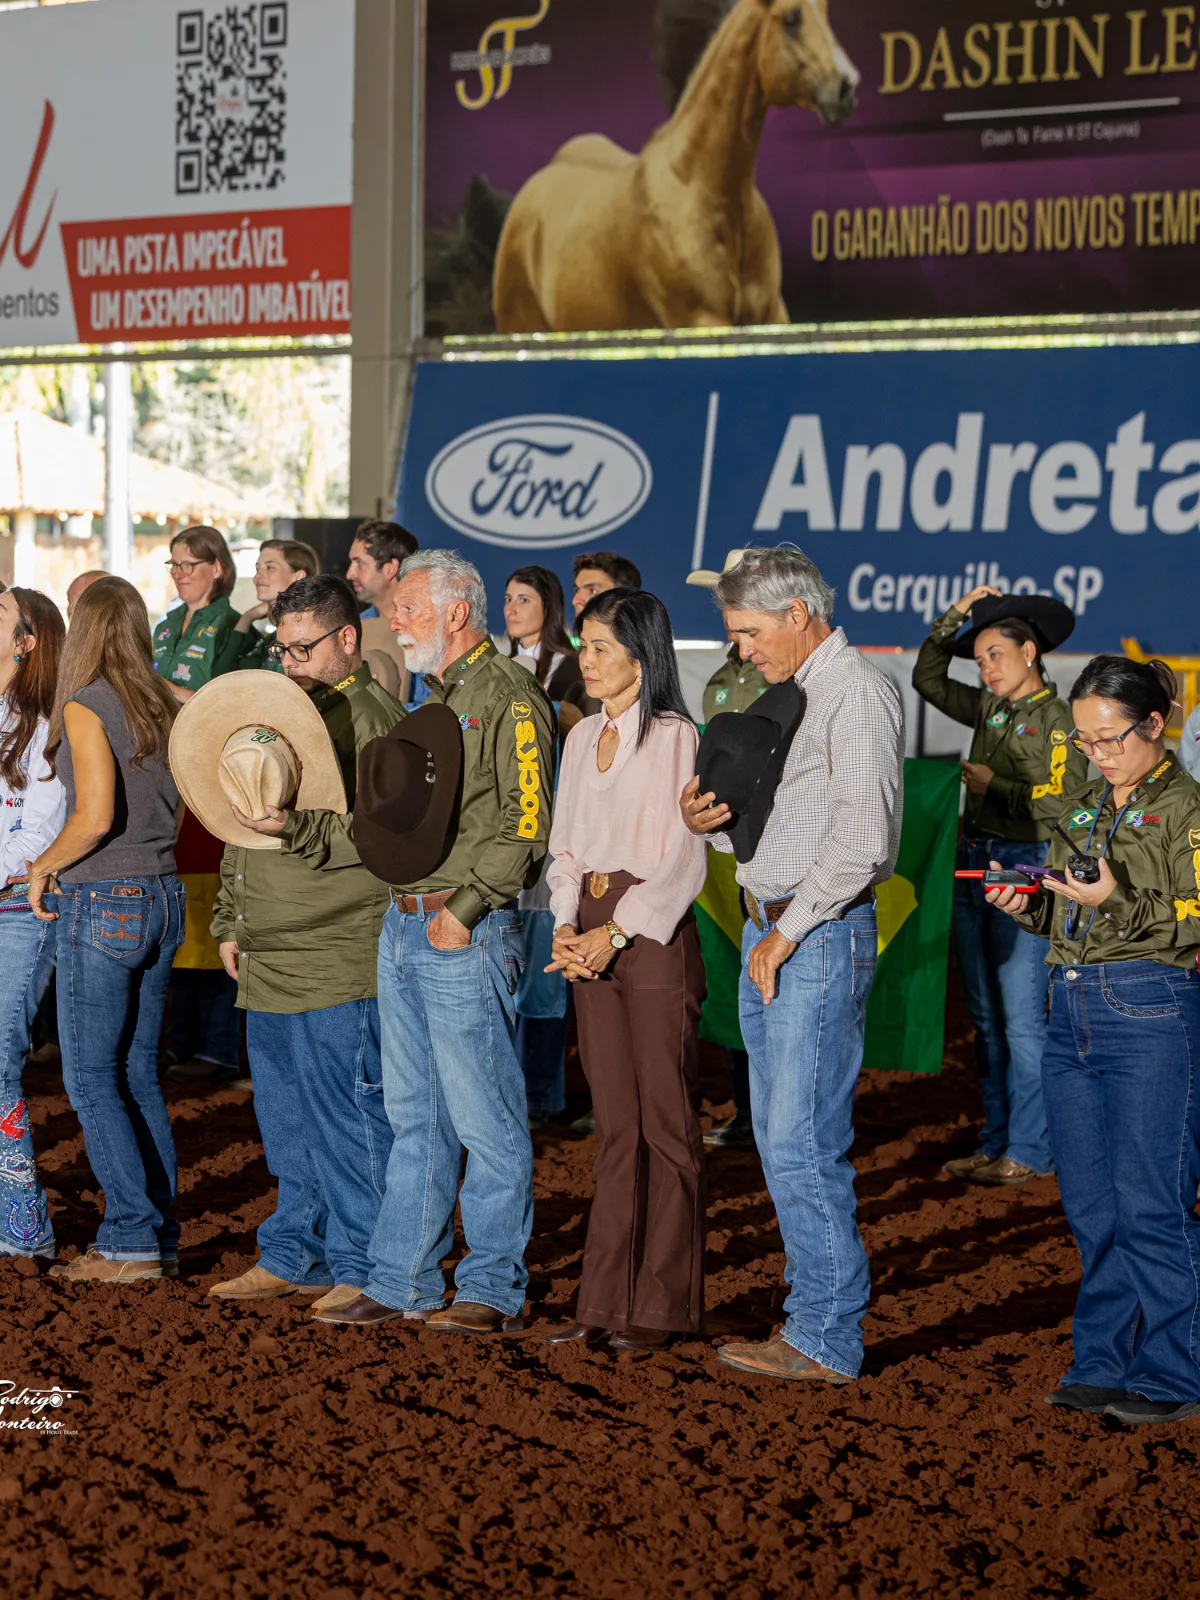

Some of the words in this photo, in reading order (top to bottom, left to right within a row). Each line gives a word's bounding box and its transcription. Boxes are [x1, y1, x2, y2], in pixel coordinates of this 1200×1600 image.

[878, 13, 1110, 94] DASHIN
[1124, 5, 1200, 77] LE
[77, 235, 121, 278] UMA
[125, 233, 178, 275] PISTA
[182, 219, 288, 272] IMPECÁVEL
[811, 209, 829, 262] O
[834, 193, 970, 261] GARANHÃO
[976, 199, 1029, 255] DOS
[1034, 193, 1125, 252] NOVOS
[90, 292, 120, 331] UM
[123, 284, 243, 329] DESEMPENHO
[248, 270, 351, 323] IMBATÍVEL
[470, 437, 606, 520] Ford
[466, 640, 491, 664] DOCK'S
[515, 720, 541, 839] DOCK'S
